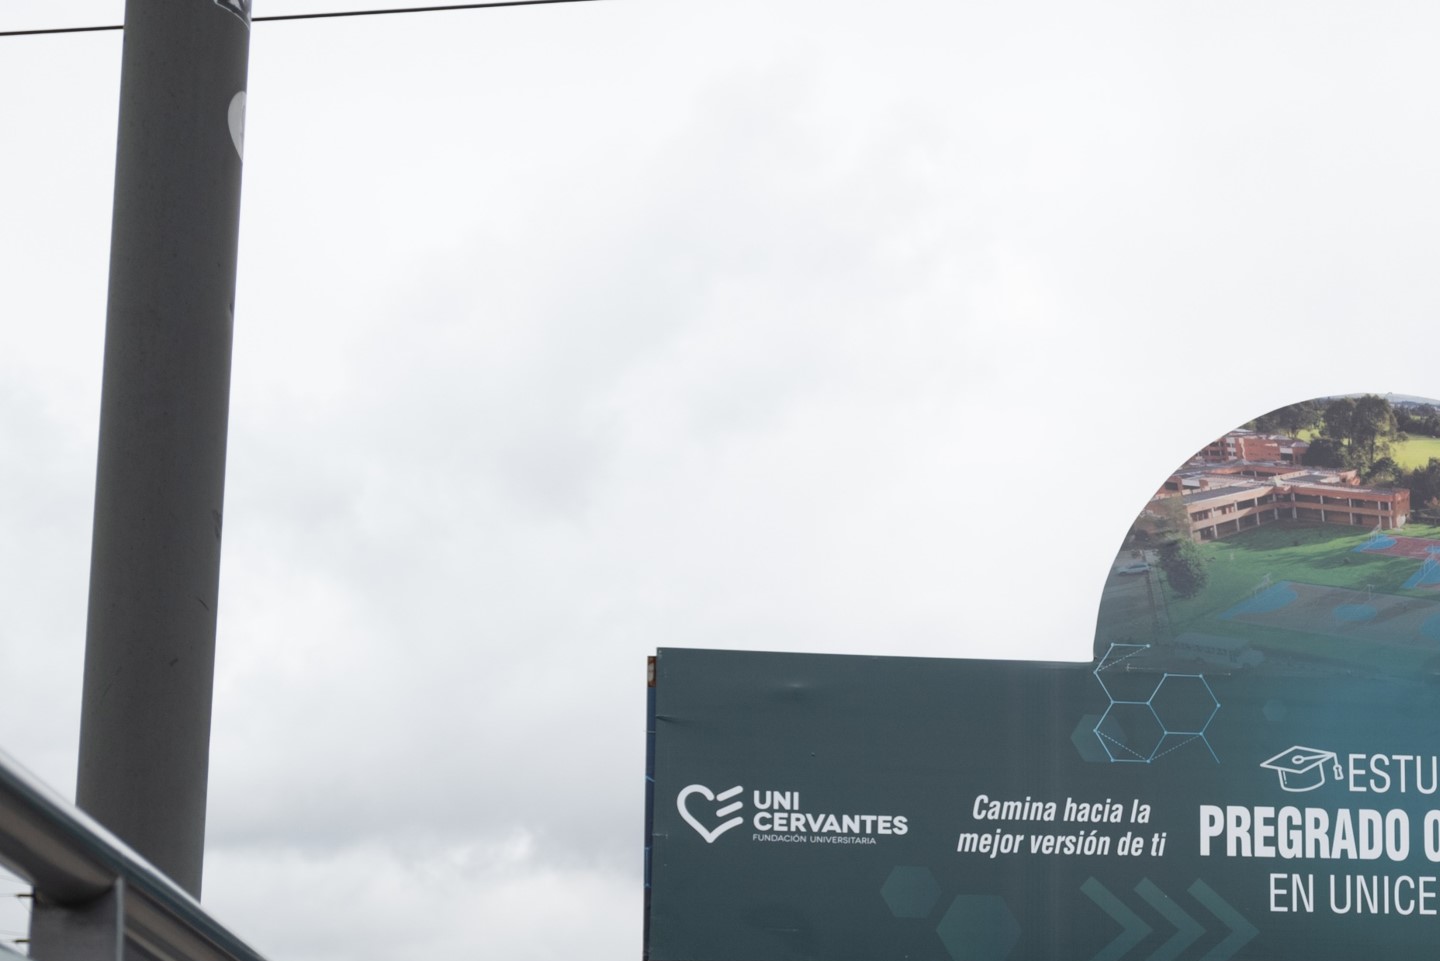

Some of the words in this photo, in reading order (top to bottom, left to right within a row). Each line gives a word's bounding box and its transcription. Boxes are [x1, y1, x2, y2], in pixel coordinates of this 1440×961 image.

[754, 791, 799, 810] UNI
[973, 795, 1056, 821] Camina
[1064, 798, 1123, 822] hacia
[1130, 799, 1150, 823] la
[753, 812, 908, 835] CERVANTES
[1200, 805, 1409, 861] PREGRADO
[752, 833, 807, 843] FUNDACIÓN
[810, 836, 877, 845] UNIVERSITARIA
[957, 828, 1024, 858] mejor
[1031, 830, 1110, 855] versión
[1117, 832, 1142, 856] de
[1151, 833, 1166, 856] ti
[1270, 873, 1313, 912] EN
